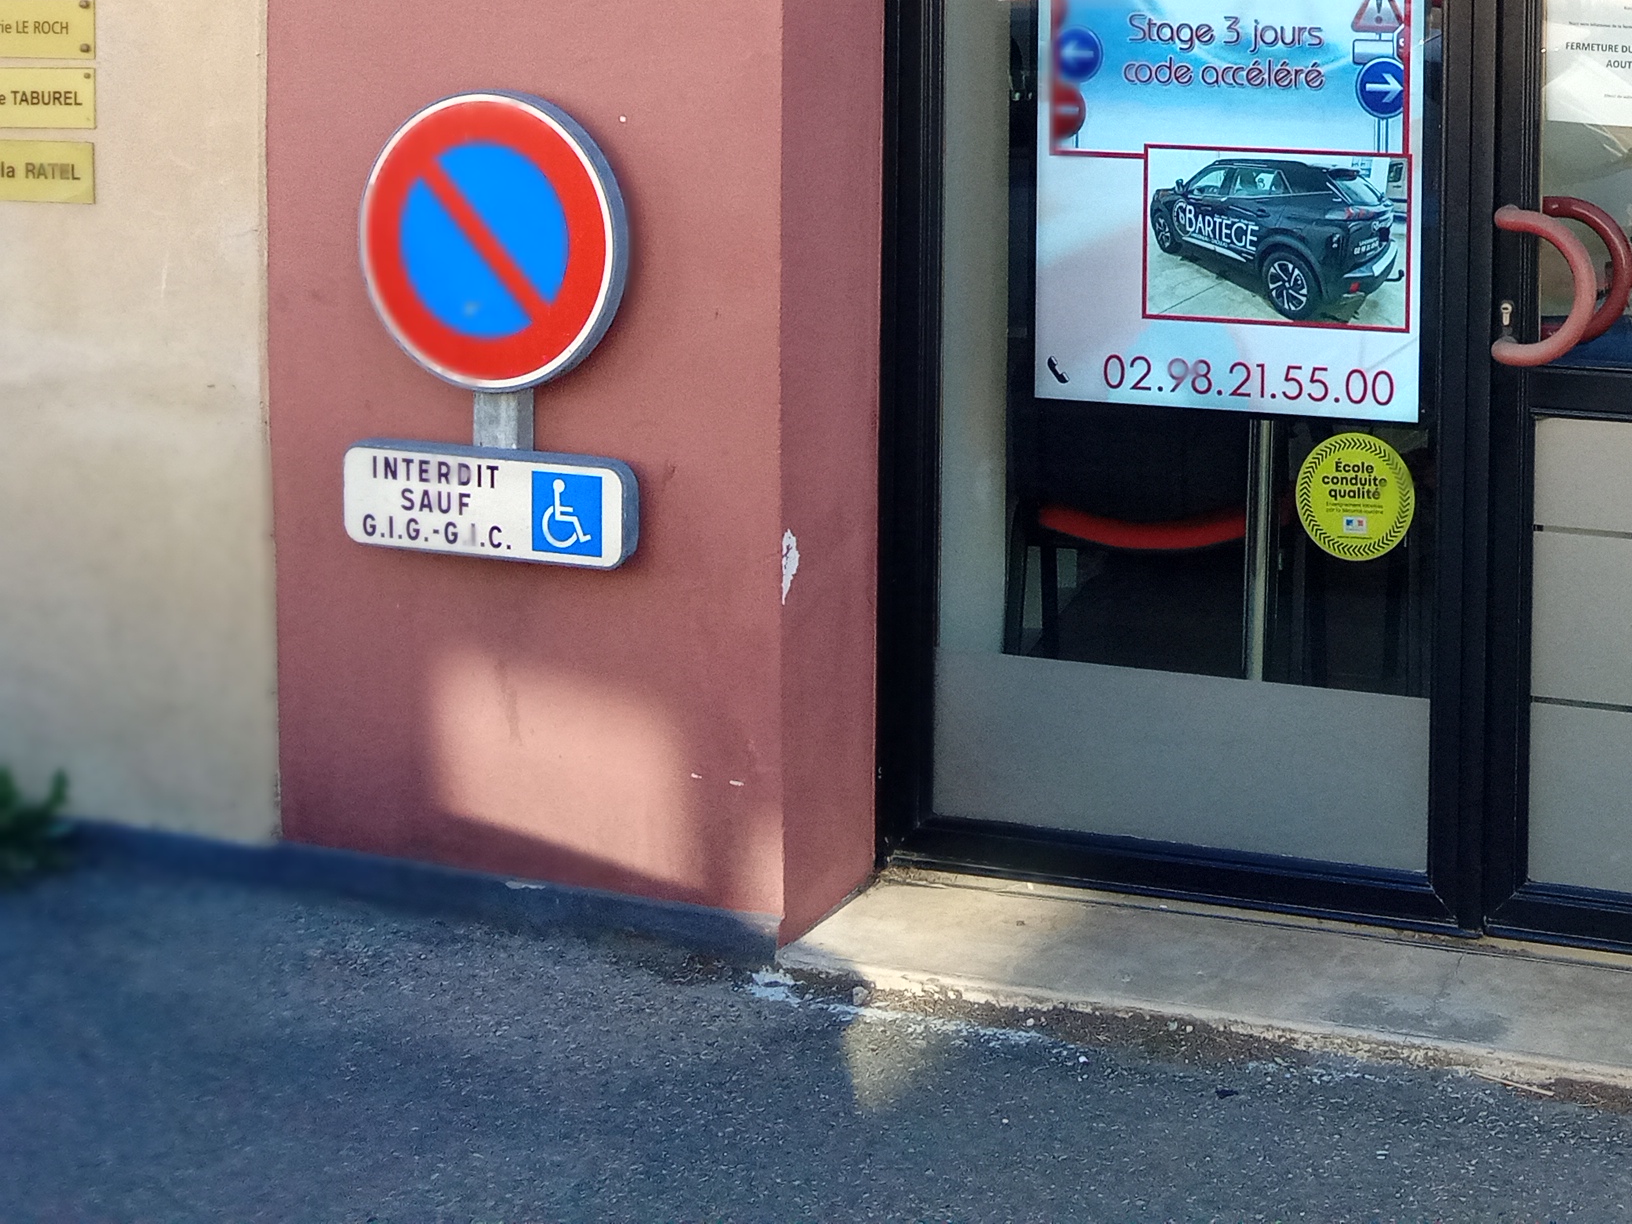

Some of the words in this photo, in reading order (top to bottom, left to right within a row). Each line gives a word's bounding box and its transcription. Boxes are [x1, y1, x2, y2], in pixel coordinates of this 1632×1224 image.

[16, 21, 29, 34] LE
[33, 21, 69, 35] ROCH
[1128, 13, 1215, 51] Stage
[1223, 15, 1241, 45] 3
[1249, 18, 1325, 54] jours
[1565, 42, 1619, 53] FERMETURE
[1606, 60, 1632, 70] AOUT
[1123, 57, 1193, 86] code
[1201, 59, 1325, 90] accéléré
[11, 91, 83, 106] TABUREL
[1186, 204, 1259, 251] BARTEGE
[1103, 353, 1395, 406] 02.98.21.55.00
[372, 455, 499, 488] INTERDIT
[1335, 458, 1374, 474] École
[1322, 474, 1387, 488] conduite
[400, 487, 471, 516] SAUF
[1329, 487, 1381, 501] qualité
